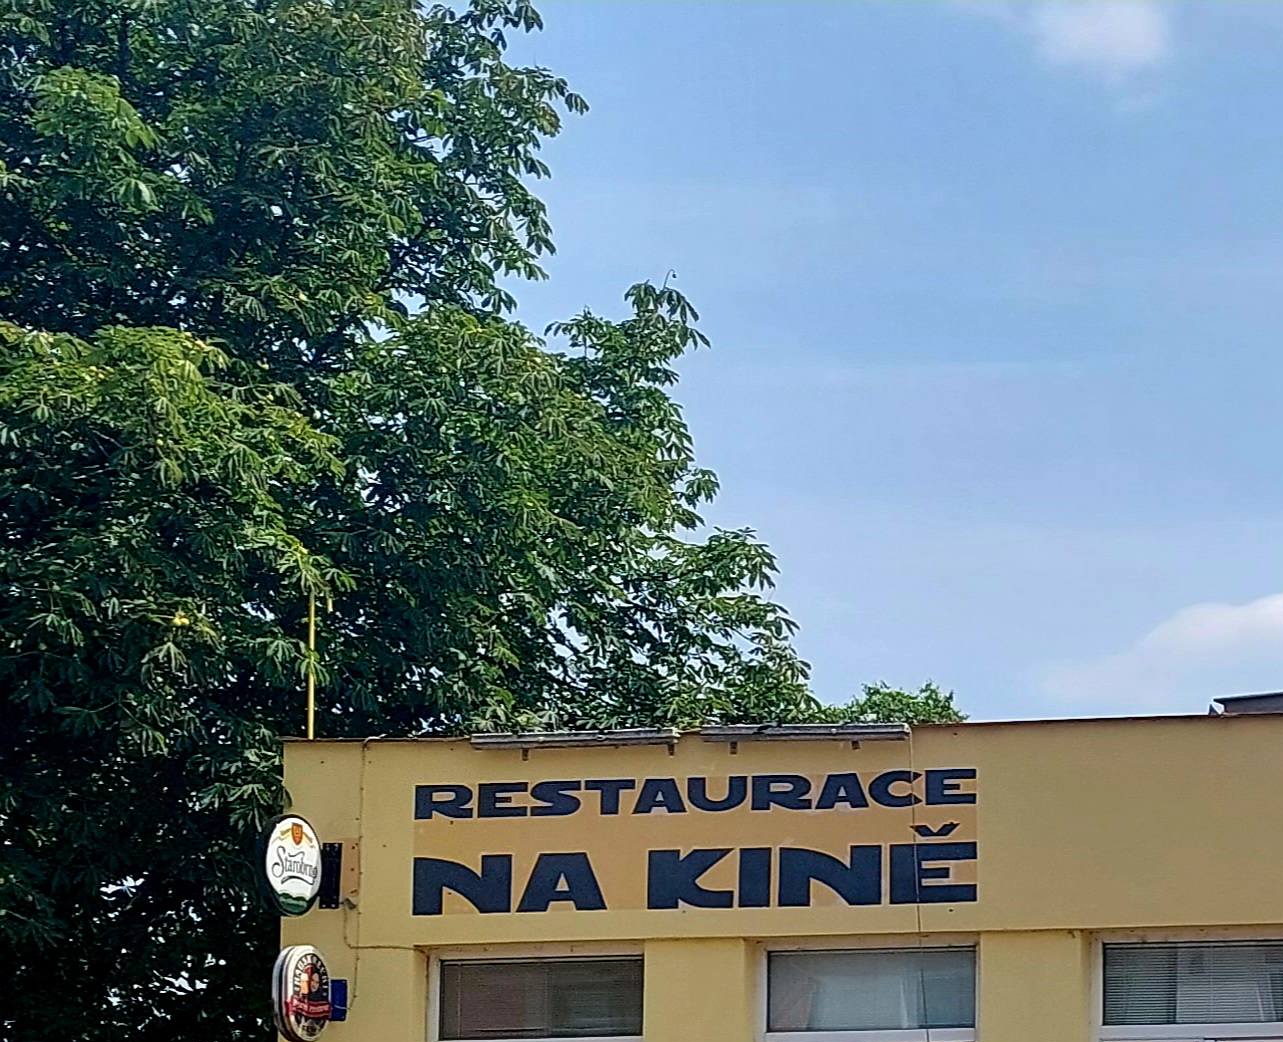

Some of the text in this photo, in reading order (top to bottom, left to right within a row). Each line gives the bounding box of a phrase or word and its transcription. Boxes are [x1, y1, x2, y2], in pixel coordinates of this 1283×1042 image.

[414, 768, 977, 820] RESTAURACE
[412, 822, 977, 916] NA KINĚ
